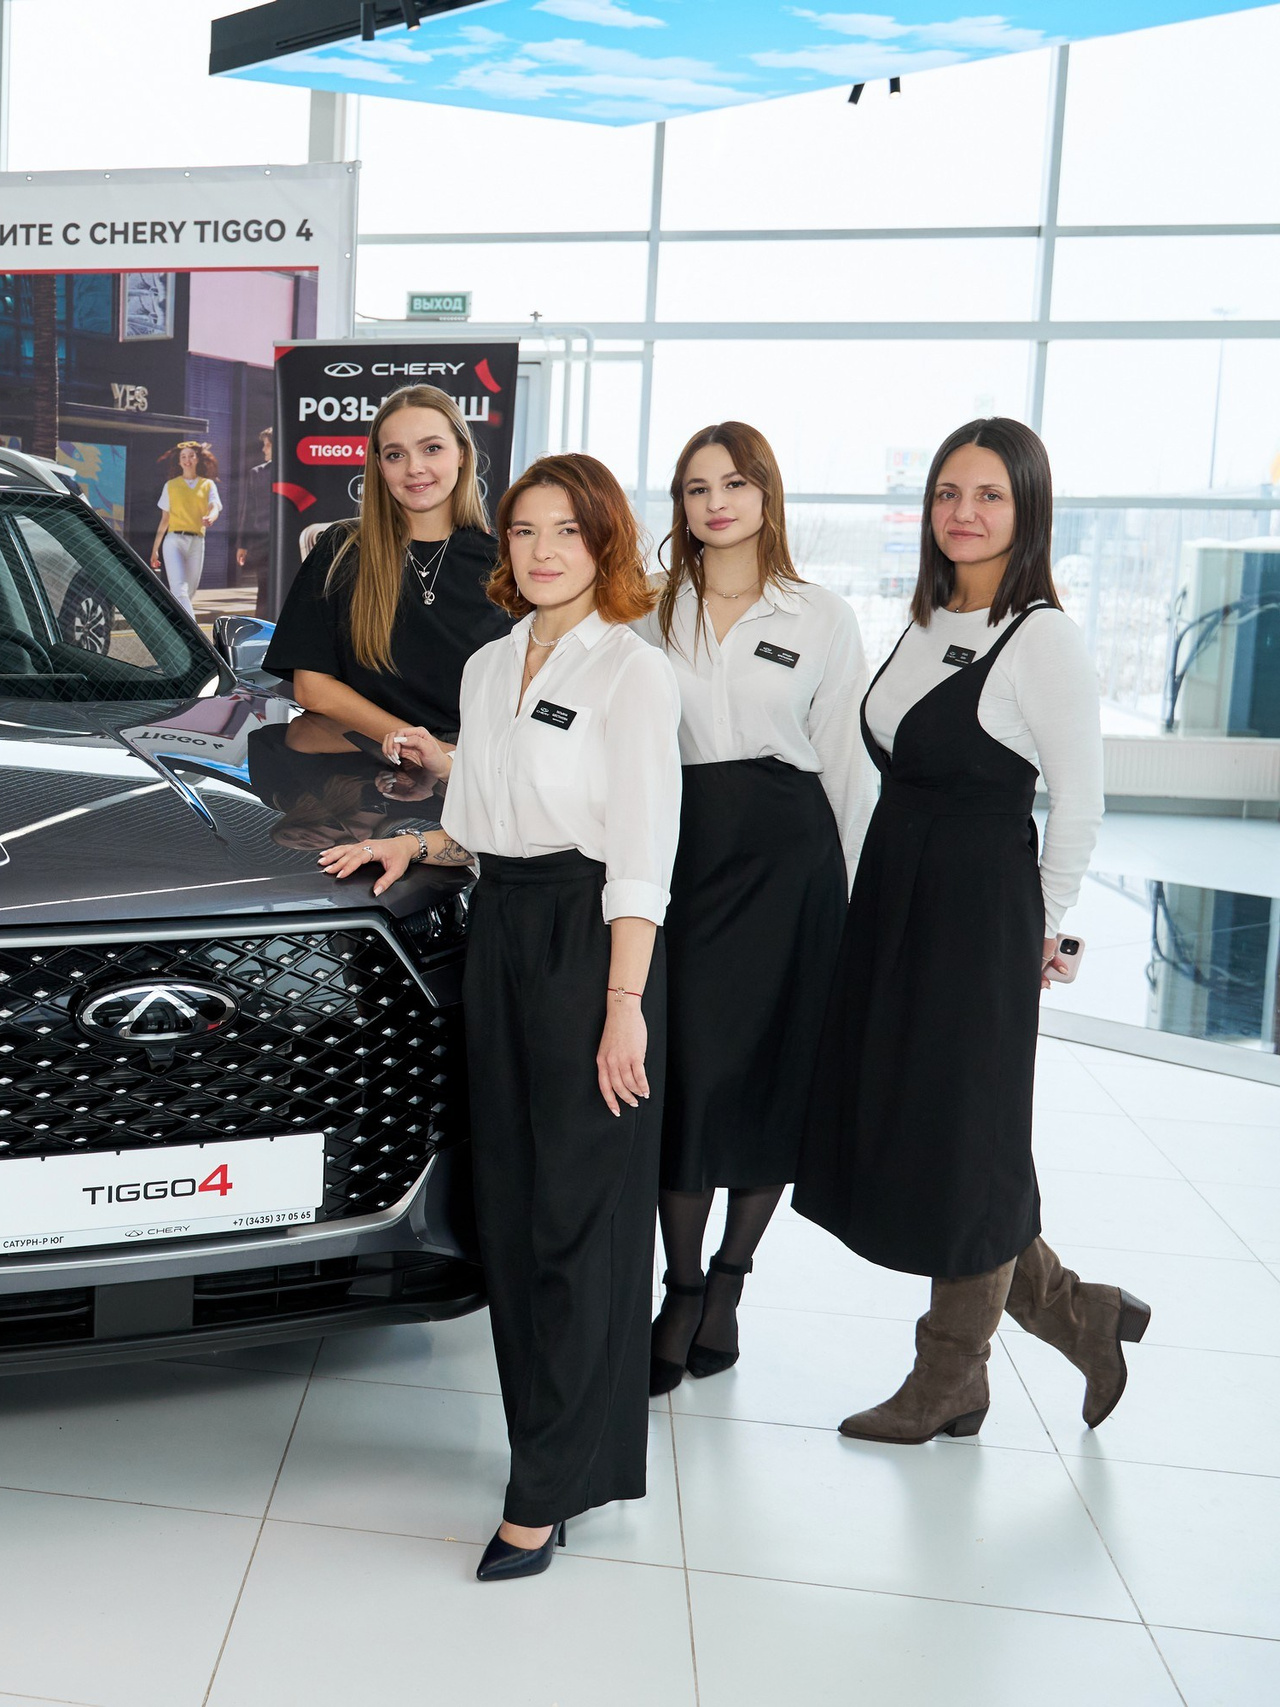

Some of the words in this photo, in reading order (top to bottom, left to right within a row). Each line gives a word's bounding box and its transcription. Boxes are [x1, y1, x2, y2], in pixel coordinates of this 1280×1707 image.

[61, 222, 81, 246] С
[89, 221, 187, 245] CHERY
[193, 219, 286, 243] TIGGO
[295, 218, 314, 242] 4
[412, 297, 463, 312] ВЫХОД
[371, 362, 466, 376] CHERY
[110, 383, 149, 412] YES
[309, 444, 353, 457] TIGGO
[355, 444, 365, 457] 4
[233, 1218, 244, 1227] +7
[245, 1212, 274, 1226] (3435)
[275, 1213, 286, 1222] 37
[288, 1212, 299, 1221] 05
[300, 1211, 311, 1220] 65
[147, 1225, 191, 1235] CHERY
[2, 1237, 49, 1249] САТУРН-Р
[50, 1236, 65, 1244] ЮГ
